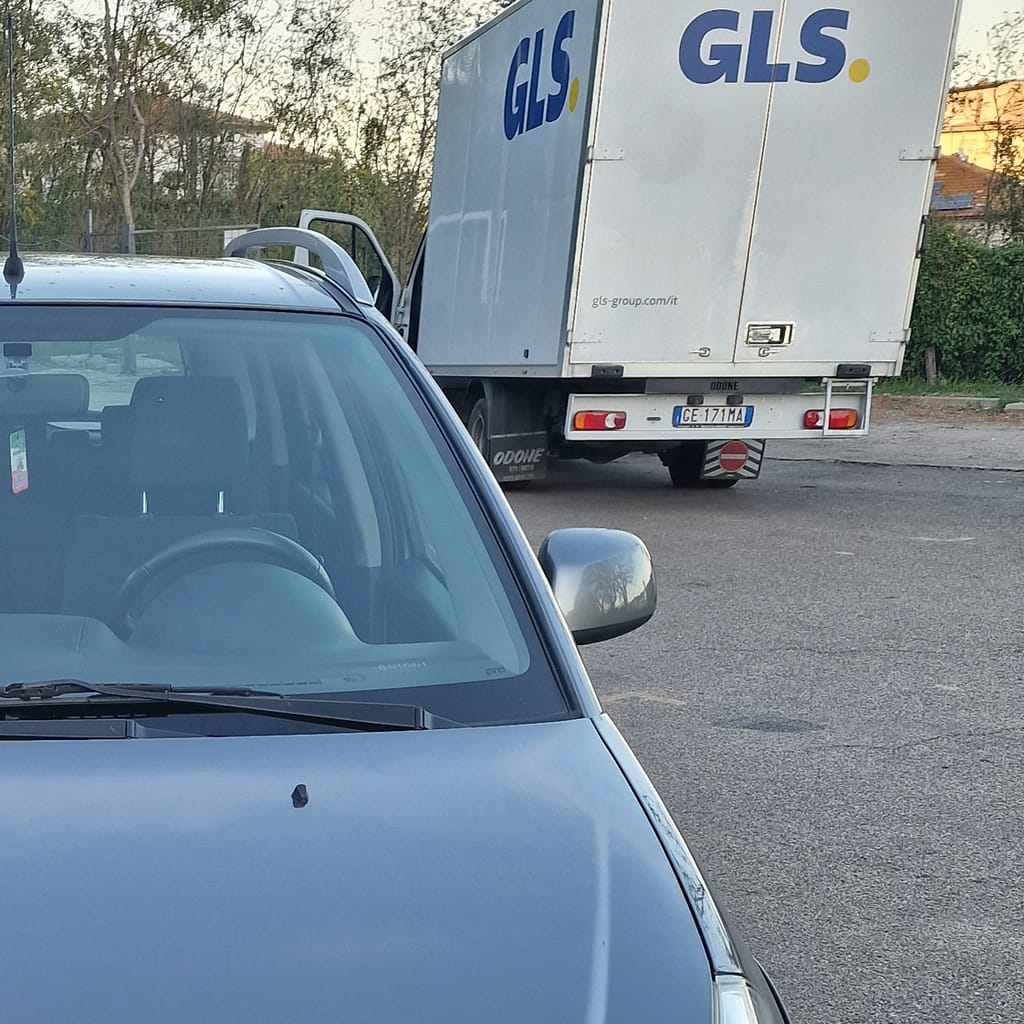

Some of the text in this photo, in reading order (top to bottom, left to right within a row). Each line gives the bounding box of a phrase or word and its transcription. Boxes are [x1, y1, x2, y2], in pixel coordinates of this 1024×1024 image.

[592, 295, 678, 309] gls-group.com/it
[710, 381, 740, 391] ODONE
[682, 408, 743, 423] GE 171MA
[493, 447, 545, 466] ODONE
